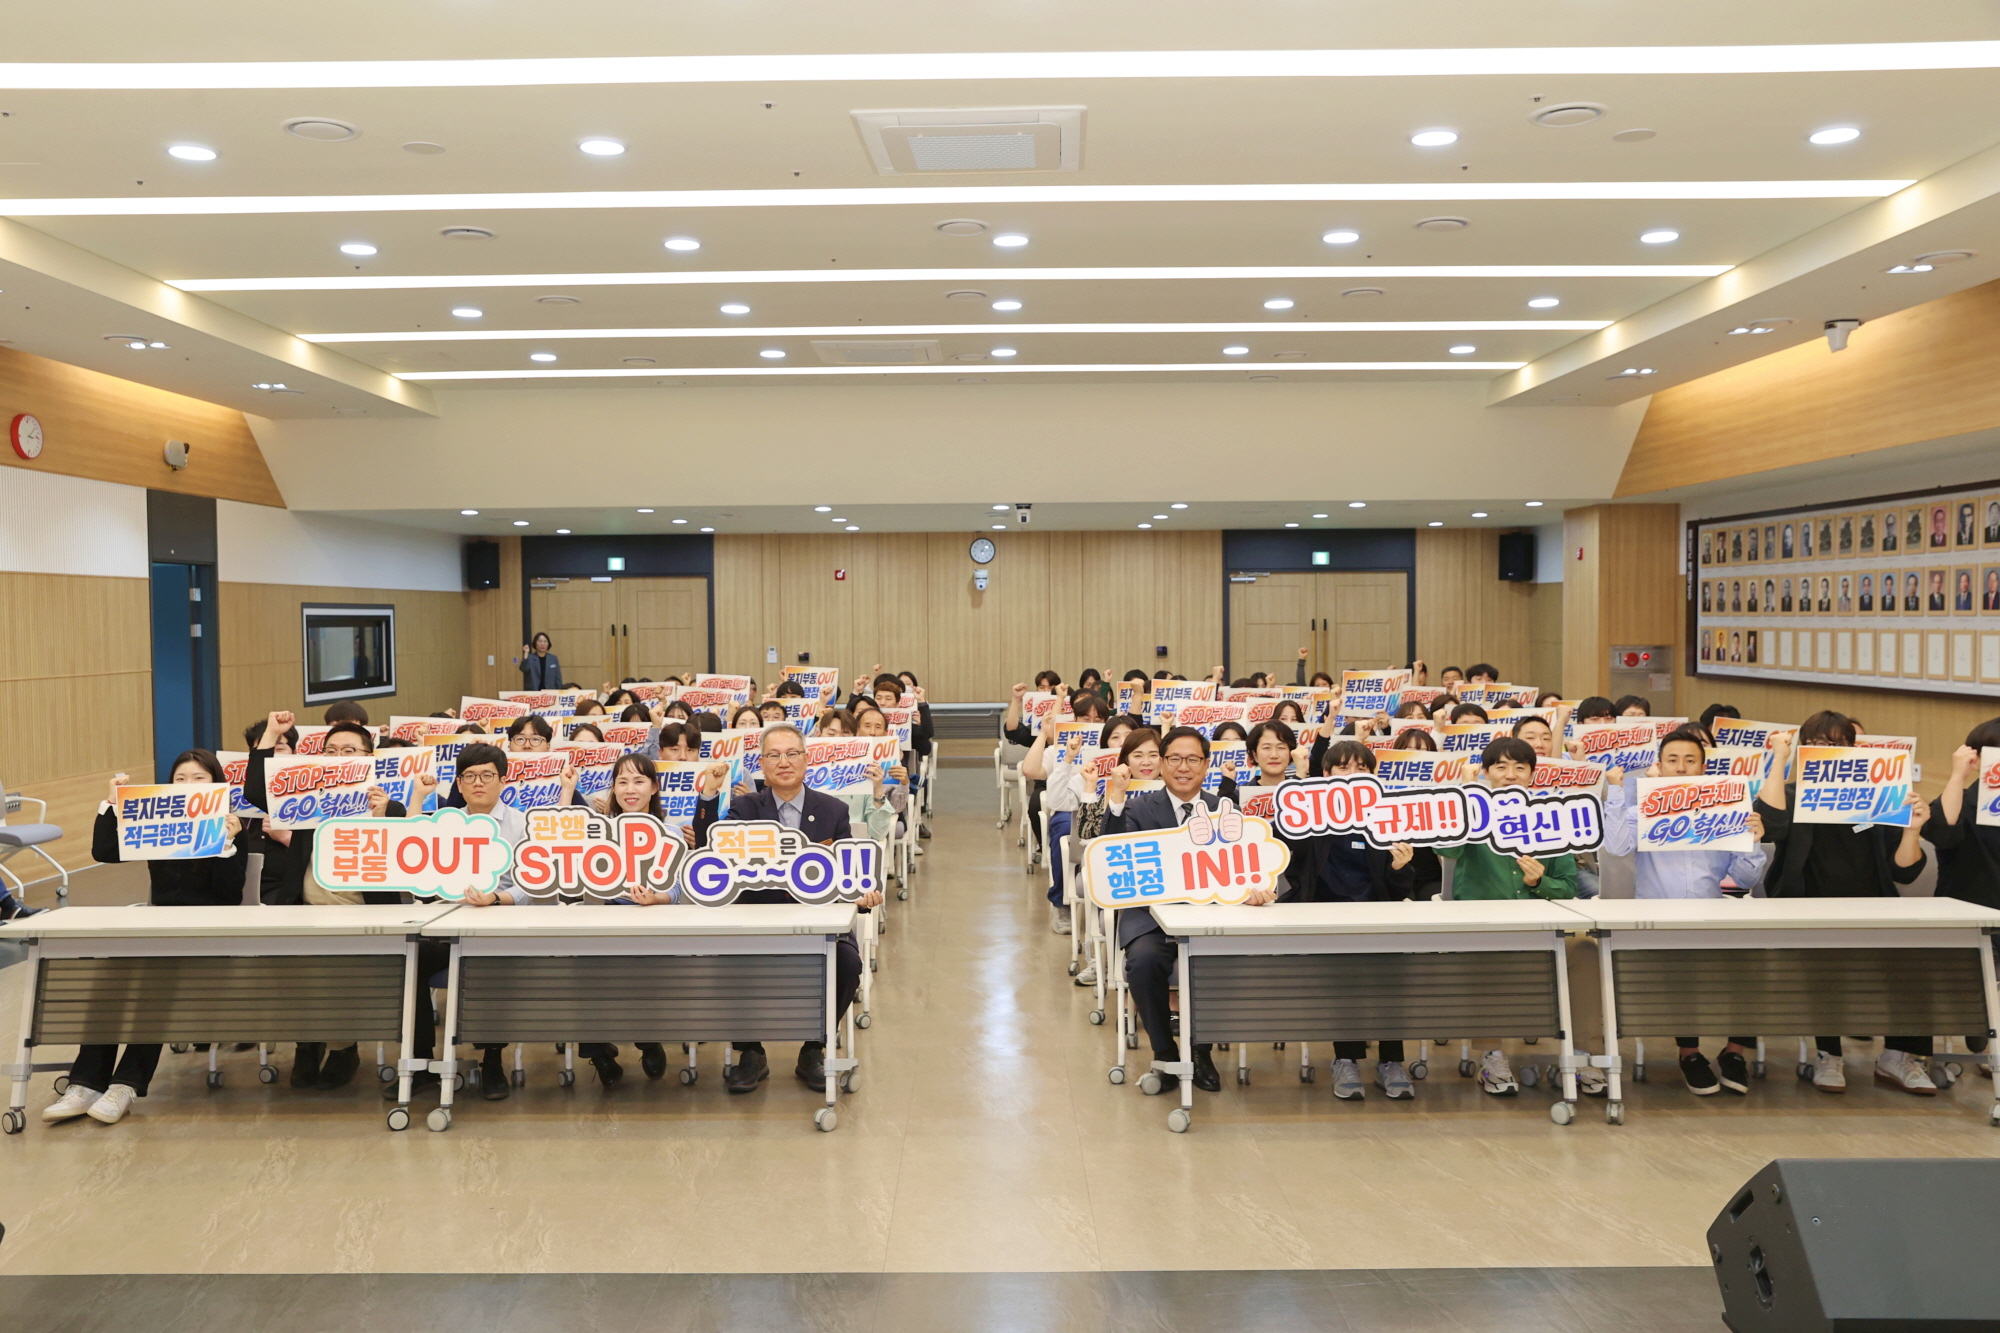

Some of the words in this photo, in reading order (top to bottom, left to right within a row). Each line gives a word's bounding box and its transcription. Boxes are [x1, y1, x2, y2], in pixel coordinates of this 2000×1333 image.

[817, 671, 837, 685] OUT
[1383, 675, 1404, 694] OUT
[803, 687, 820, 699] 행정
[1192, 685, 1215, 702] OUT
[1344, 695, 1387, 710] 적극행정
[1385, 693, 1402, 713] IN
[1460, 689, 1484, 703] 복지부
[1212, 705, 1244, 722] 규제!!
[1249, 705, 1276, 721] STO
[712, 736, 742, 760] OUT
[873, 739, 898, 761] OUT
[1618, 728, 1653, 747] 규제!!
[1715, 728, 1766, 749] 복지부동,
[400, 750, 434, 778] OUT
[585, 748, 622, 767] 규제!!
[834, 741, 869, 761] 규제!!
[324, 763, 371, 788] 규제!!
[524, 758, 566, 779] 규제!!
[1433, 757, 1468, 783] OUT
[1559, 765, 1600, 786] 규제!!
[1730, 752, 1763, 777] OUT
[1802, 758, 1870, 785] 복지부동,
[1869, 754, 1908, 785] OUT
[121, 794, 187, 822] 복지부동,
[187, 787, 227, 816] OUT
[1284, 785, 1378, 829] STOP
[1699, 782, 1746, 809] 규제!!
[1800, 787, 1876, 812] 적극행정
[1869, 783, 1909, 820] IN
[277, 795, 317, 825] GO
[123, 821, 194, 849] 적극행정
[192, 816, 226, 856] IN
[532, 815, 602, 841] 관행은
[1647, 815, 1692, 847] GO
[1693, 810, 1750, 846] 혁신!!
[332, 828, 388, 855] 복지
[519, 821, 675, 888] STOP!
[716, 829, 797, 860] 적극은
[396, 836, 490, 875] OUT
[1104, 840, 1163, 870] 적극
[1181, 842, 1263, 891] IN!!
[332, 855, 388, 883] 부동
[1106, 867, 1166, 900] 행정
